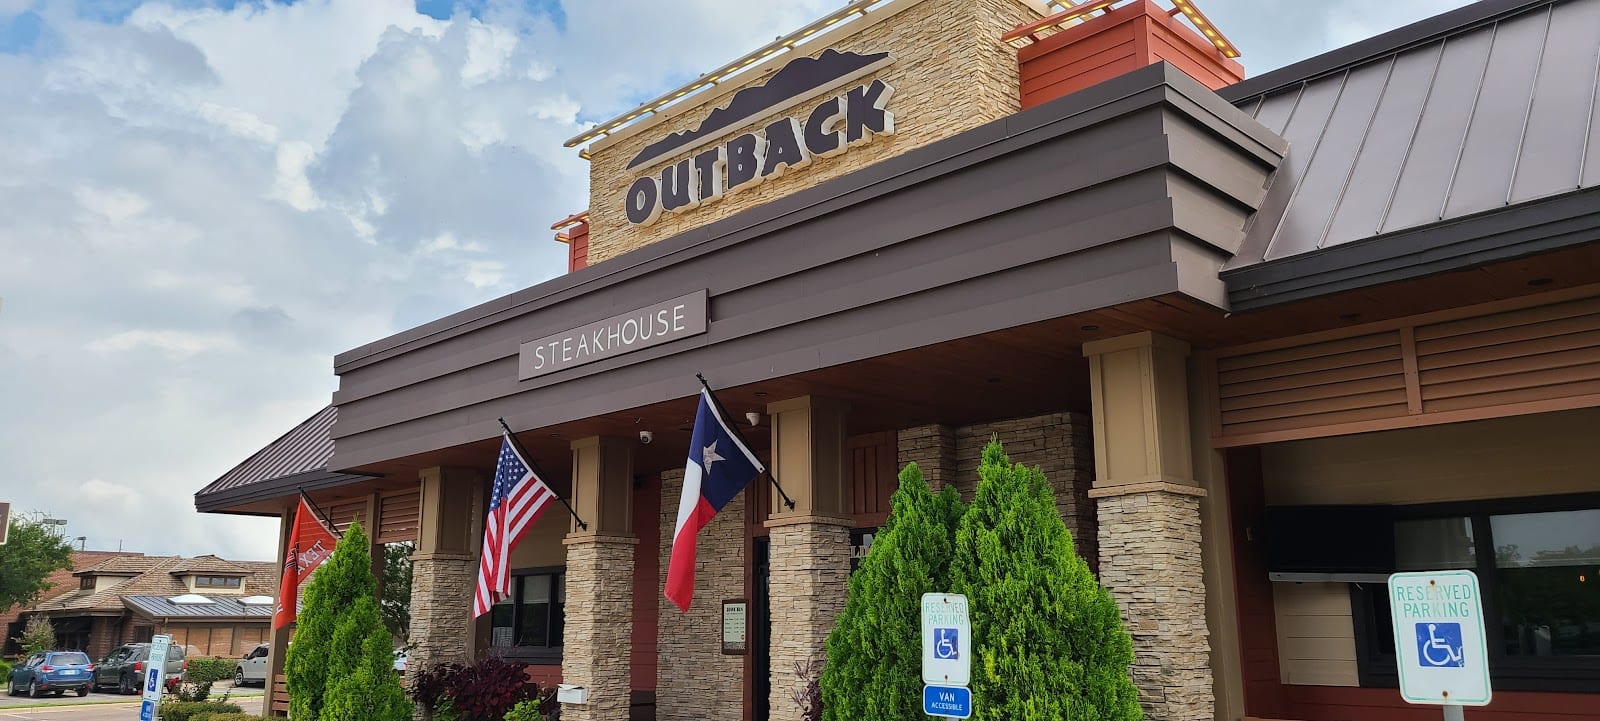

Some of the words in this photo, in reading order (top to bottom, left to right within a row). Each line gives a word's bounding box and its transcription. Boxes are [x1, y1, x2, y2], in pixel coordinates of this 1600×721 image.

[625, 79, 896, 228] OUTBACK
[534, 304, 685, 370] STEAKHOUSE
[1397, 584, 1471, 601] RESERVED
[925, 602, 964, 614] RESERVED
[1403, 602, 1469, 618] PARKING
[928, 614, 964, 625] PARKING
[939, 692, 955, 702] VAN
[931, 702, 963, 711] ACCESSIBLE
